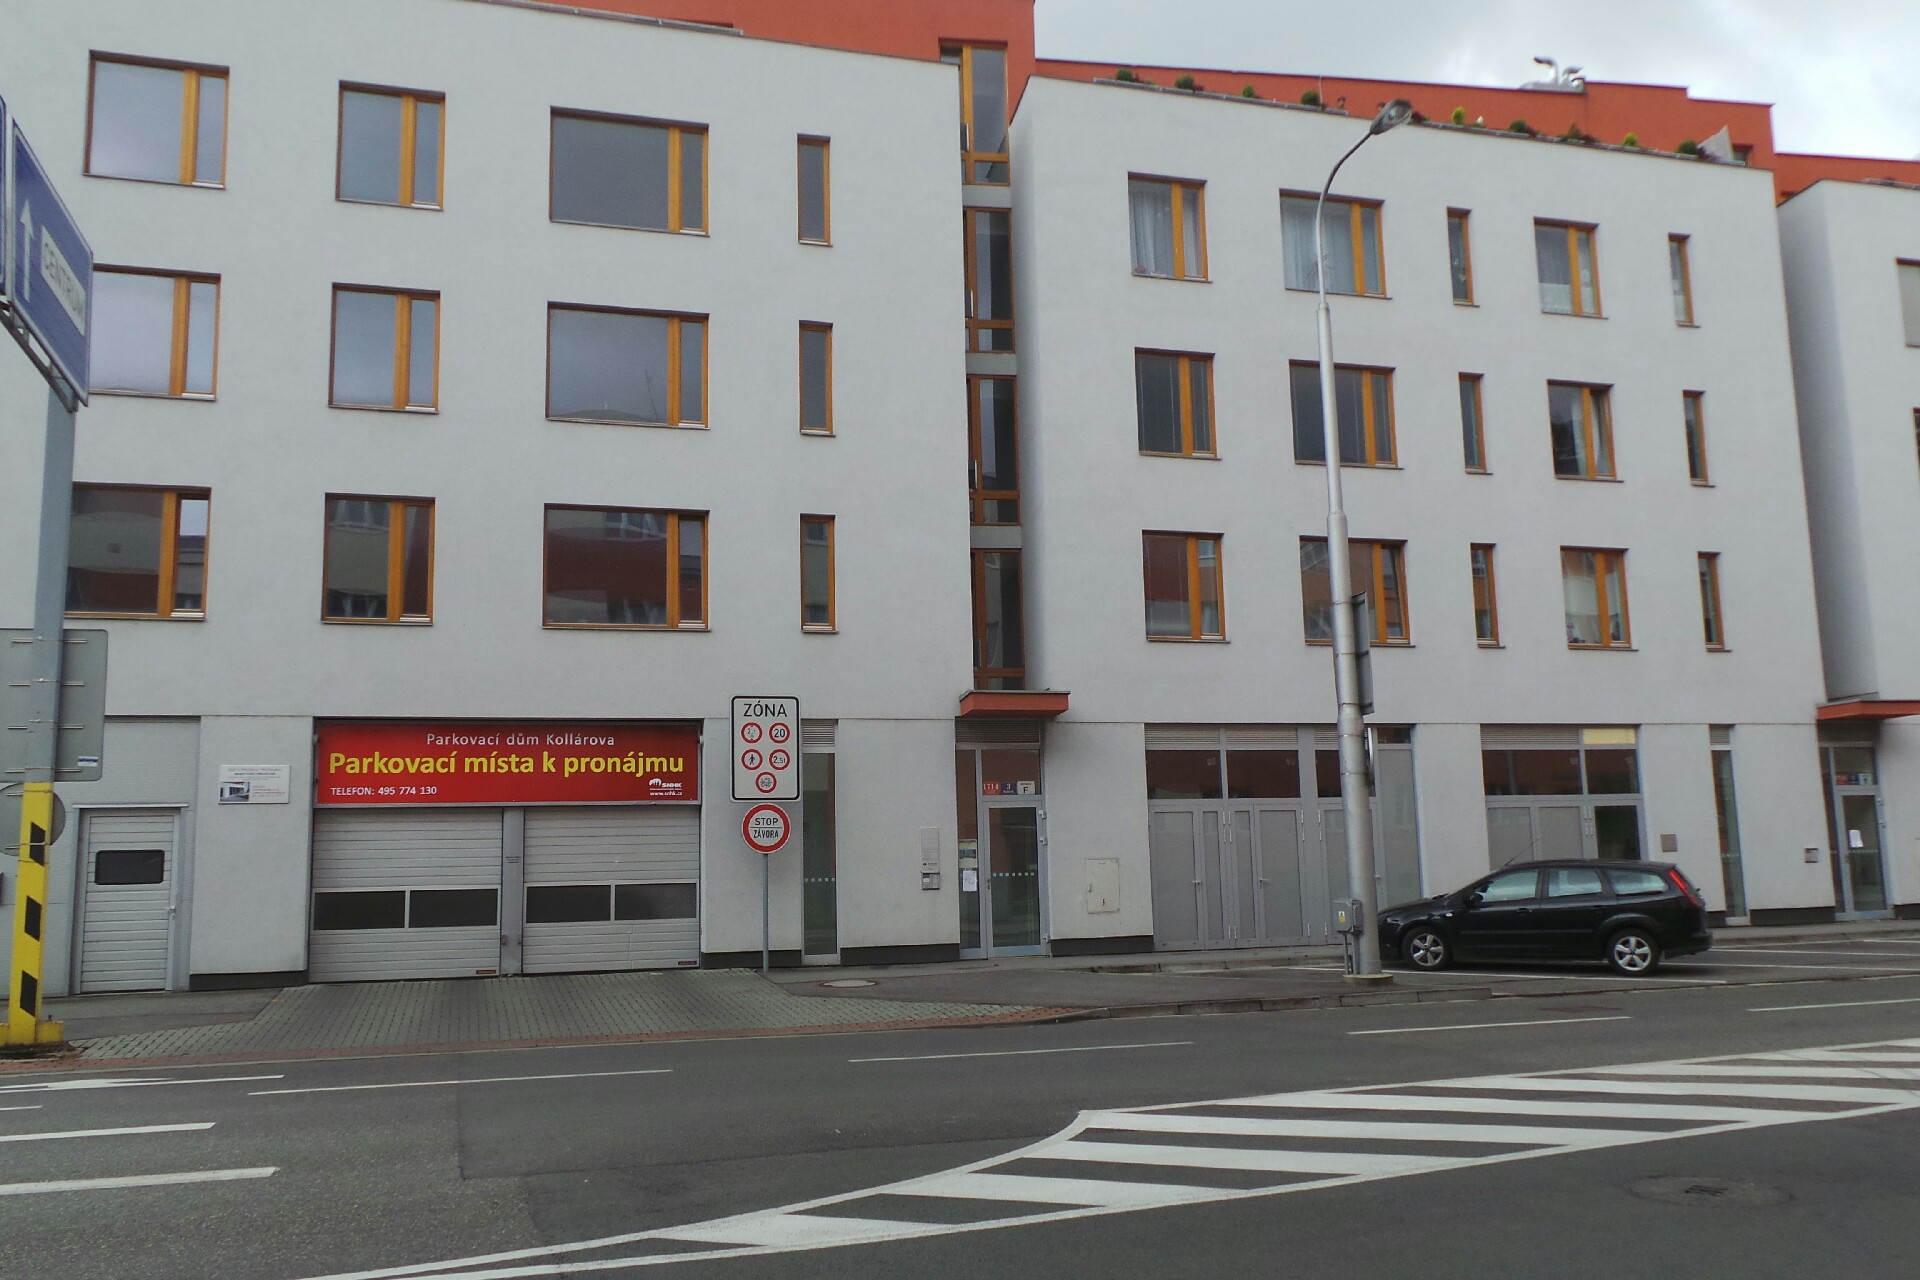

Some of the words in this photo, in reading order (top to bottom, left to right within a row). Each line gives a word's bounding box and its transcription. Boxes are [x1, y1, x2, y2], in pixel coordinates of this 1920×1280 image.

[743, 701, 788, 717] ZÓNA
[427, 732, 500, 746] Parkovací
[506, 733, 539, 746] dům
[546, 732, 615, 746] Kollárova
[774, 729, 786, 738] 20
[329, 750, 457, 774] Parkovací
[464, 750, 534, 774] místa
[542, 751, 557, 773] k
[563, 751, 684, 778] pronájmu
[330, 786, 374, 796] TELEFON:
[378, 785, 396, 796] 495
[399, 785, 417, 796] 774
[419, 785, 437, 796] 130
[1023, 786, 1029, 794] F
[754, 817, 779, 826] STOP
[753, 828, 779, 839] ZÁVORA
